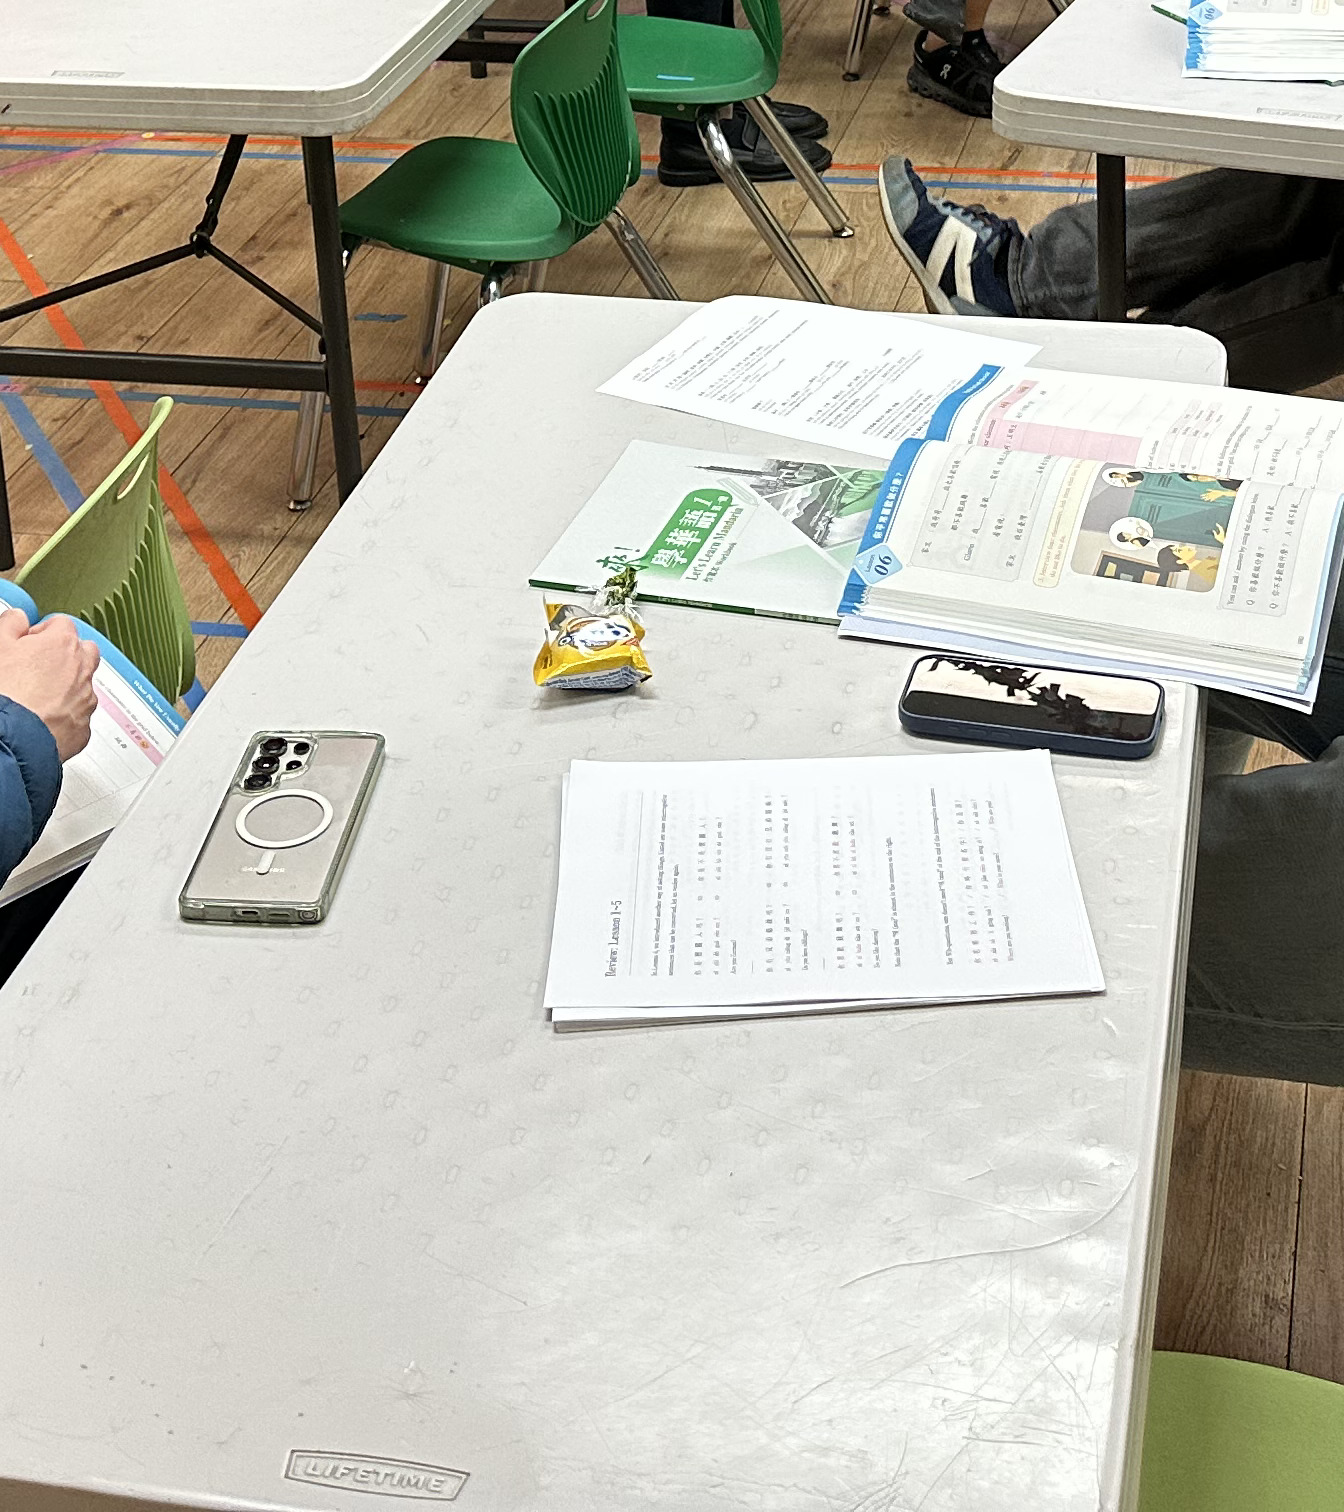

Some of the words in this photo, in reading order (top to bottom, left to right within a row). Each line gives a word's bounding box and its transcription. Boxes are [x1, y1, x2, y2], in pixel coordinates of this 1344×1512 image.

[686, 562, 706, 580] Let's
[699, 542, 721, 562] Learn
[713, 507, 744, 540] Mandarin
[874, 554, 893, 576] 06
[610, 901, 621, 915] 1~5
[307, 1458, 447, 1493] LIFETIME
